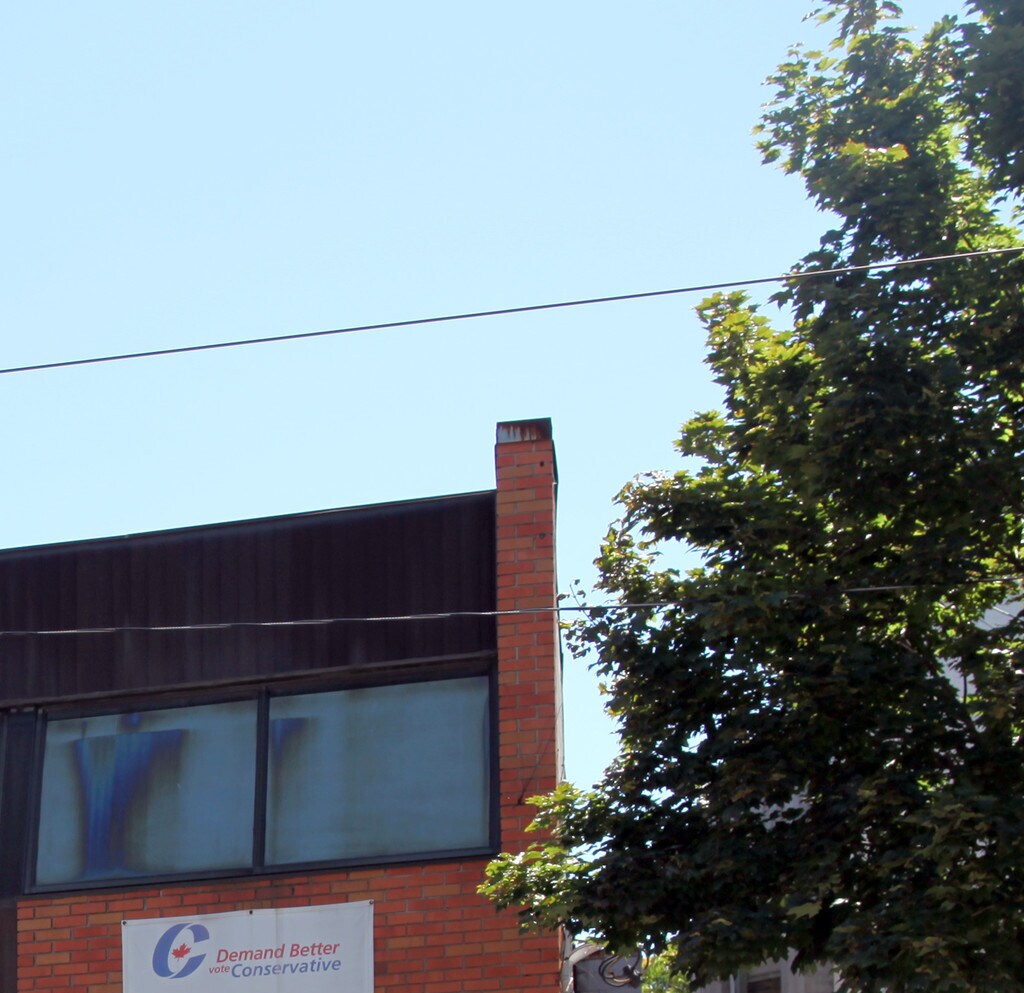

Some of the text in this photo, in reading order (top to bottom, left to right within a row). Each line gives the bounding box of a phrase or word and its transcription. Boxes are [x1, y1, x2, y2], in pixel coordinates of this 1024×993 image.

[216, 942, 341, 963] Demand Better
[208, 957, 342, 978] vote Conservative
